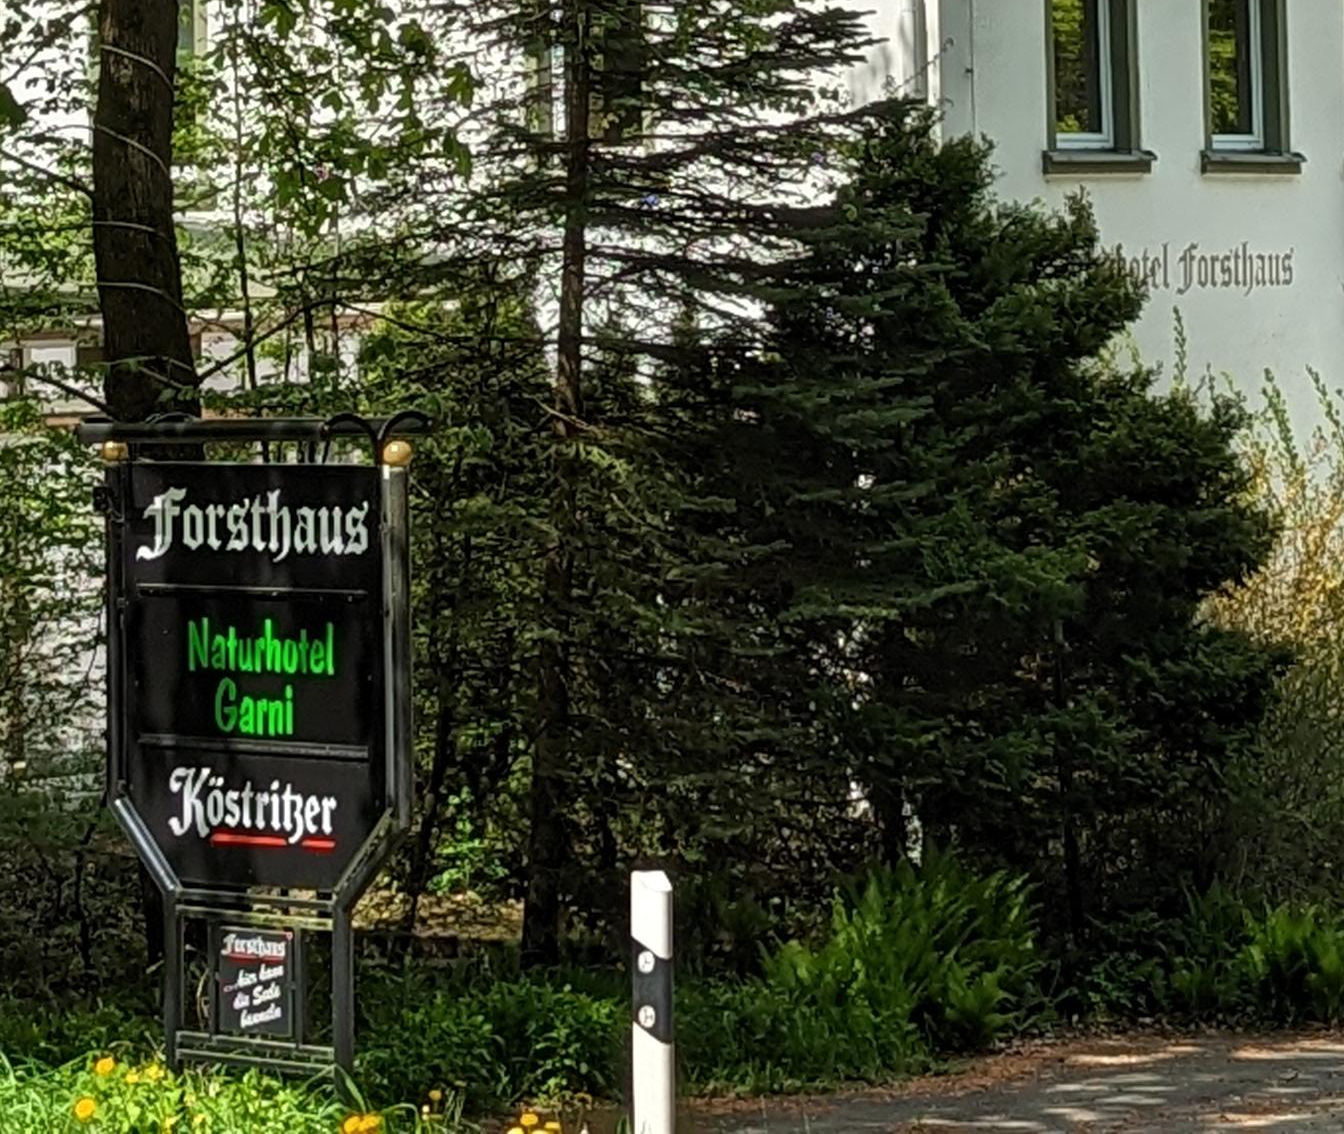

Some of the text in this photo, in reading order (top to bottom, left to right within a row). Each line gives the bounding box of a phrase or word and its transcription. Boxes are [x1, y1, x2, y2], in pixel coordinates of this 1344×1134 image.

[1176, 240, 1295, 297] Forsthaus
[136, 486, 370, 562] Forsthaus
[187, 616, 336, 677] Naturhotel
[213, 677, 294, 736] Garni
[168, 766, 337, 844] Köstritzer
